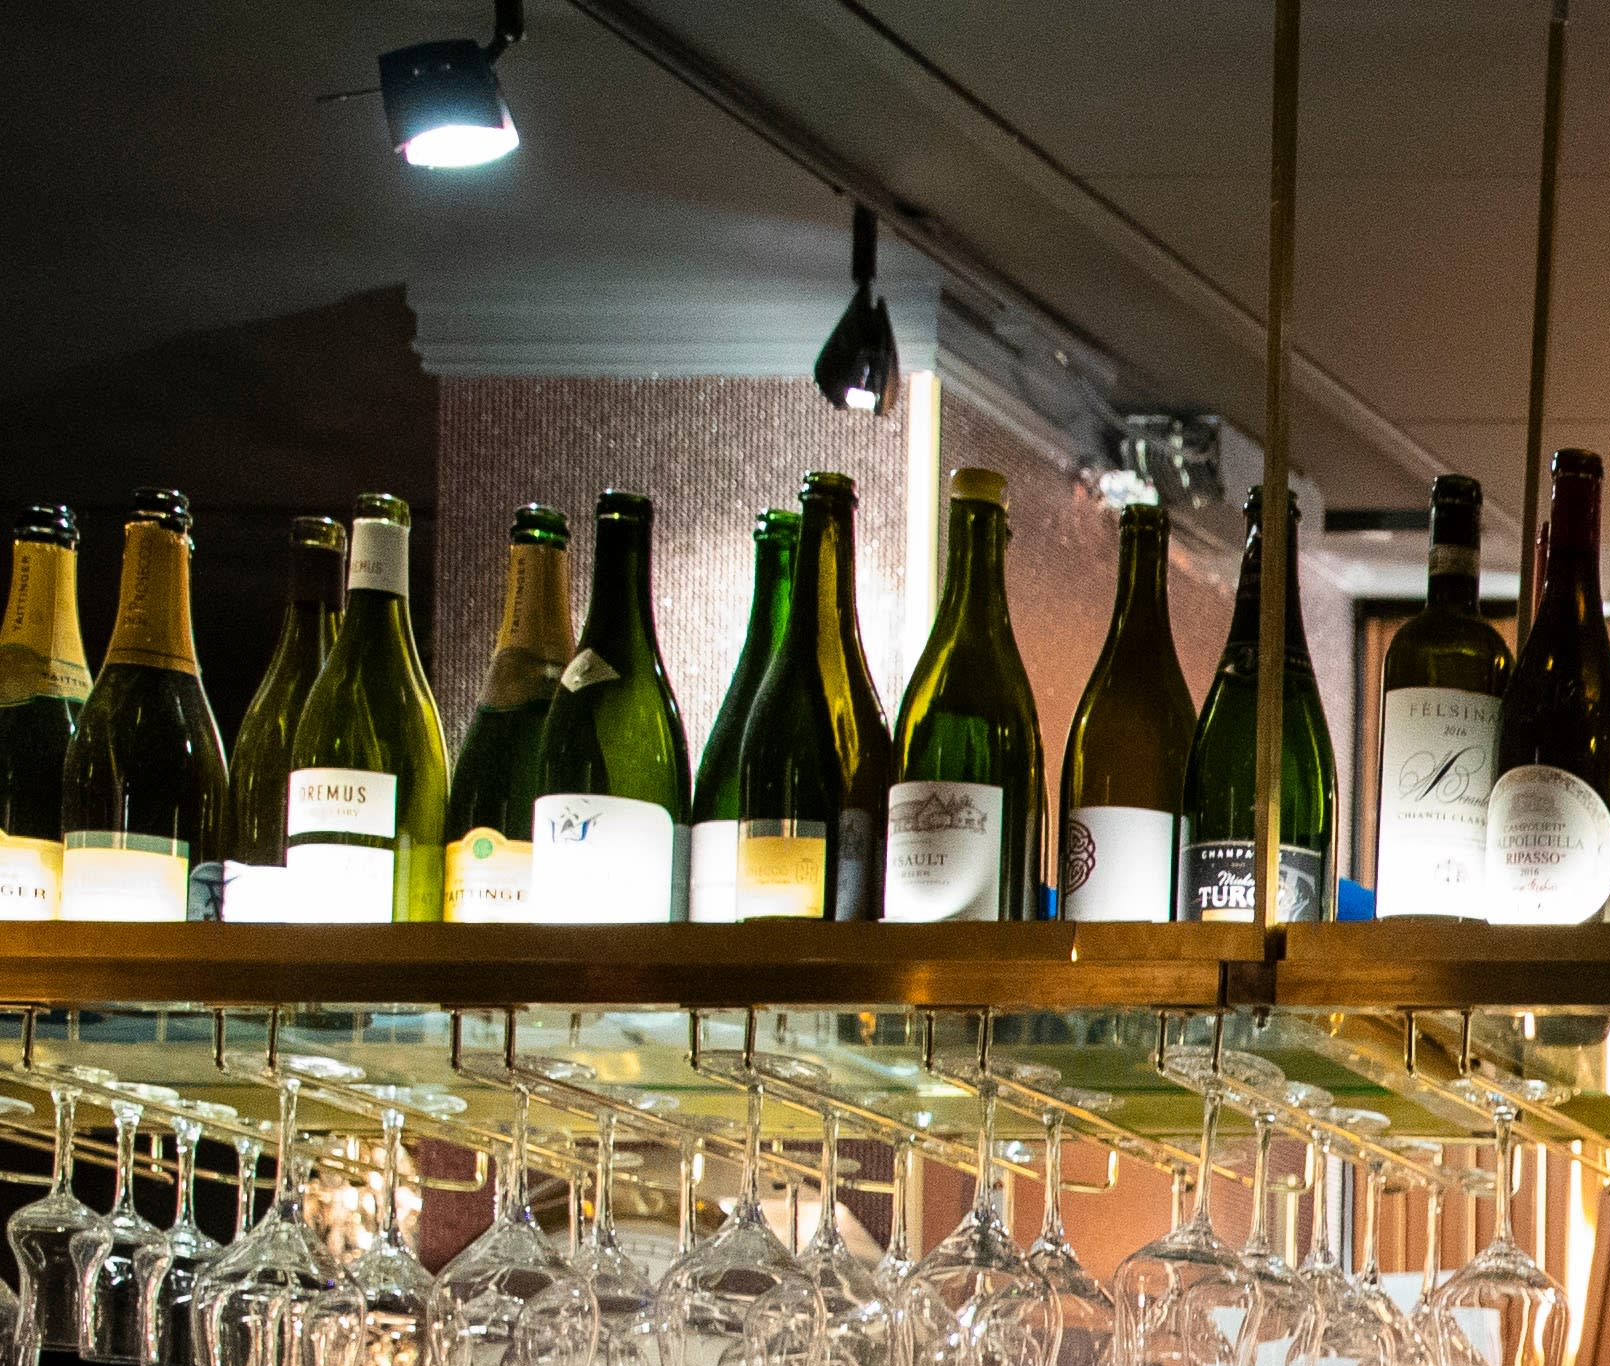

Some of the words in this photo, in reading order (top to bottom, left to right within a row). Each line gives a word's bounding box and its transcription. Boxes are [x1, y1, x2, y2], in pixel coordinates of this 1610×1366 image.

[12, 555, 31, 633] TAITTINGER
[511, 558, 525, 635] TAITTINGER
[893, 852, 949, 868] SAULT
